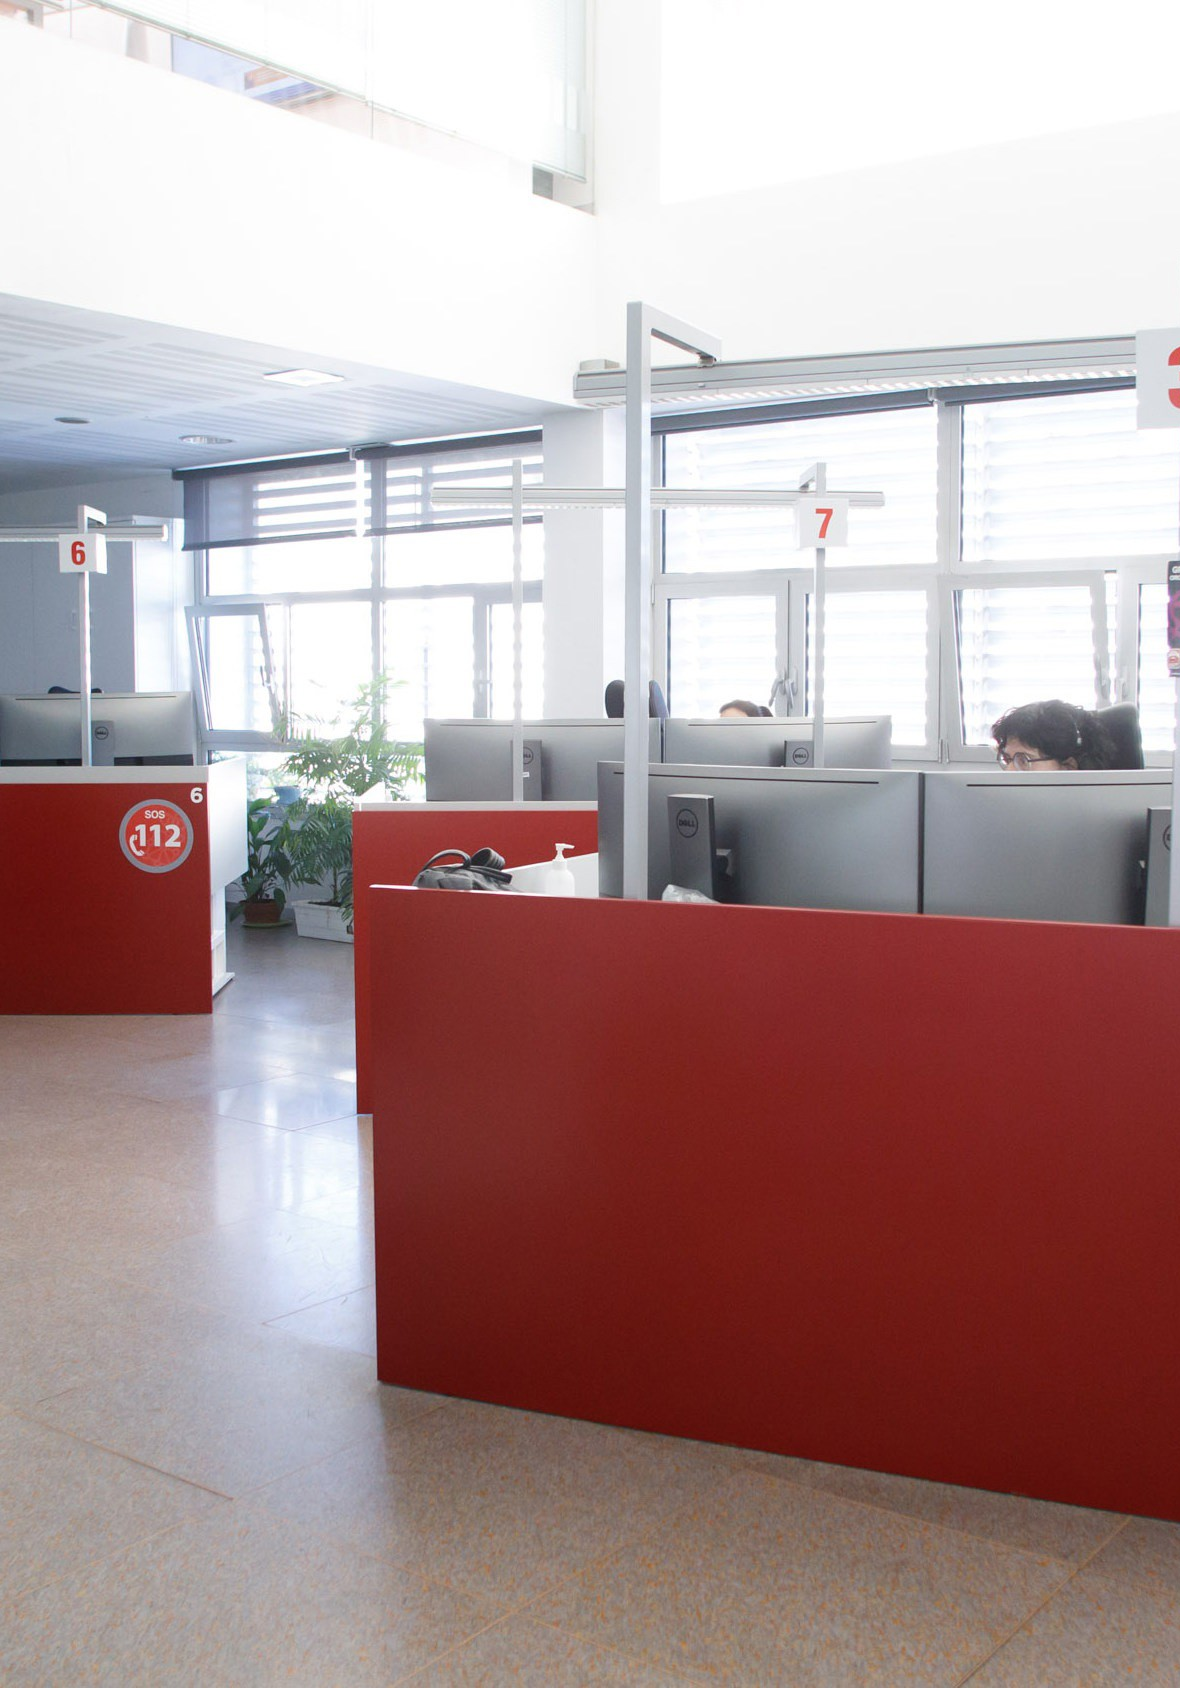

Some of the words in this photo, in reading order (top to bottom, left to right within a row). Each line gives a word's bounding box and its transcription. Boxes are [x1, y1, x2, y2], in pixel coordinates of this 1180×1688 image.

[815, 508, 833, 539] 7
[71, 540, 86, 566] 6
[190, 787, 203, 804] 6
[144, 810, 165, 819] SOS
[135, 824, 181, 848] 112
